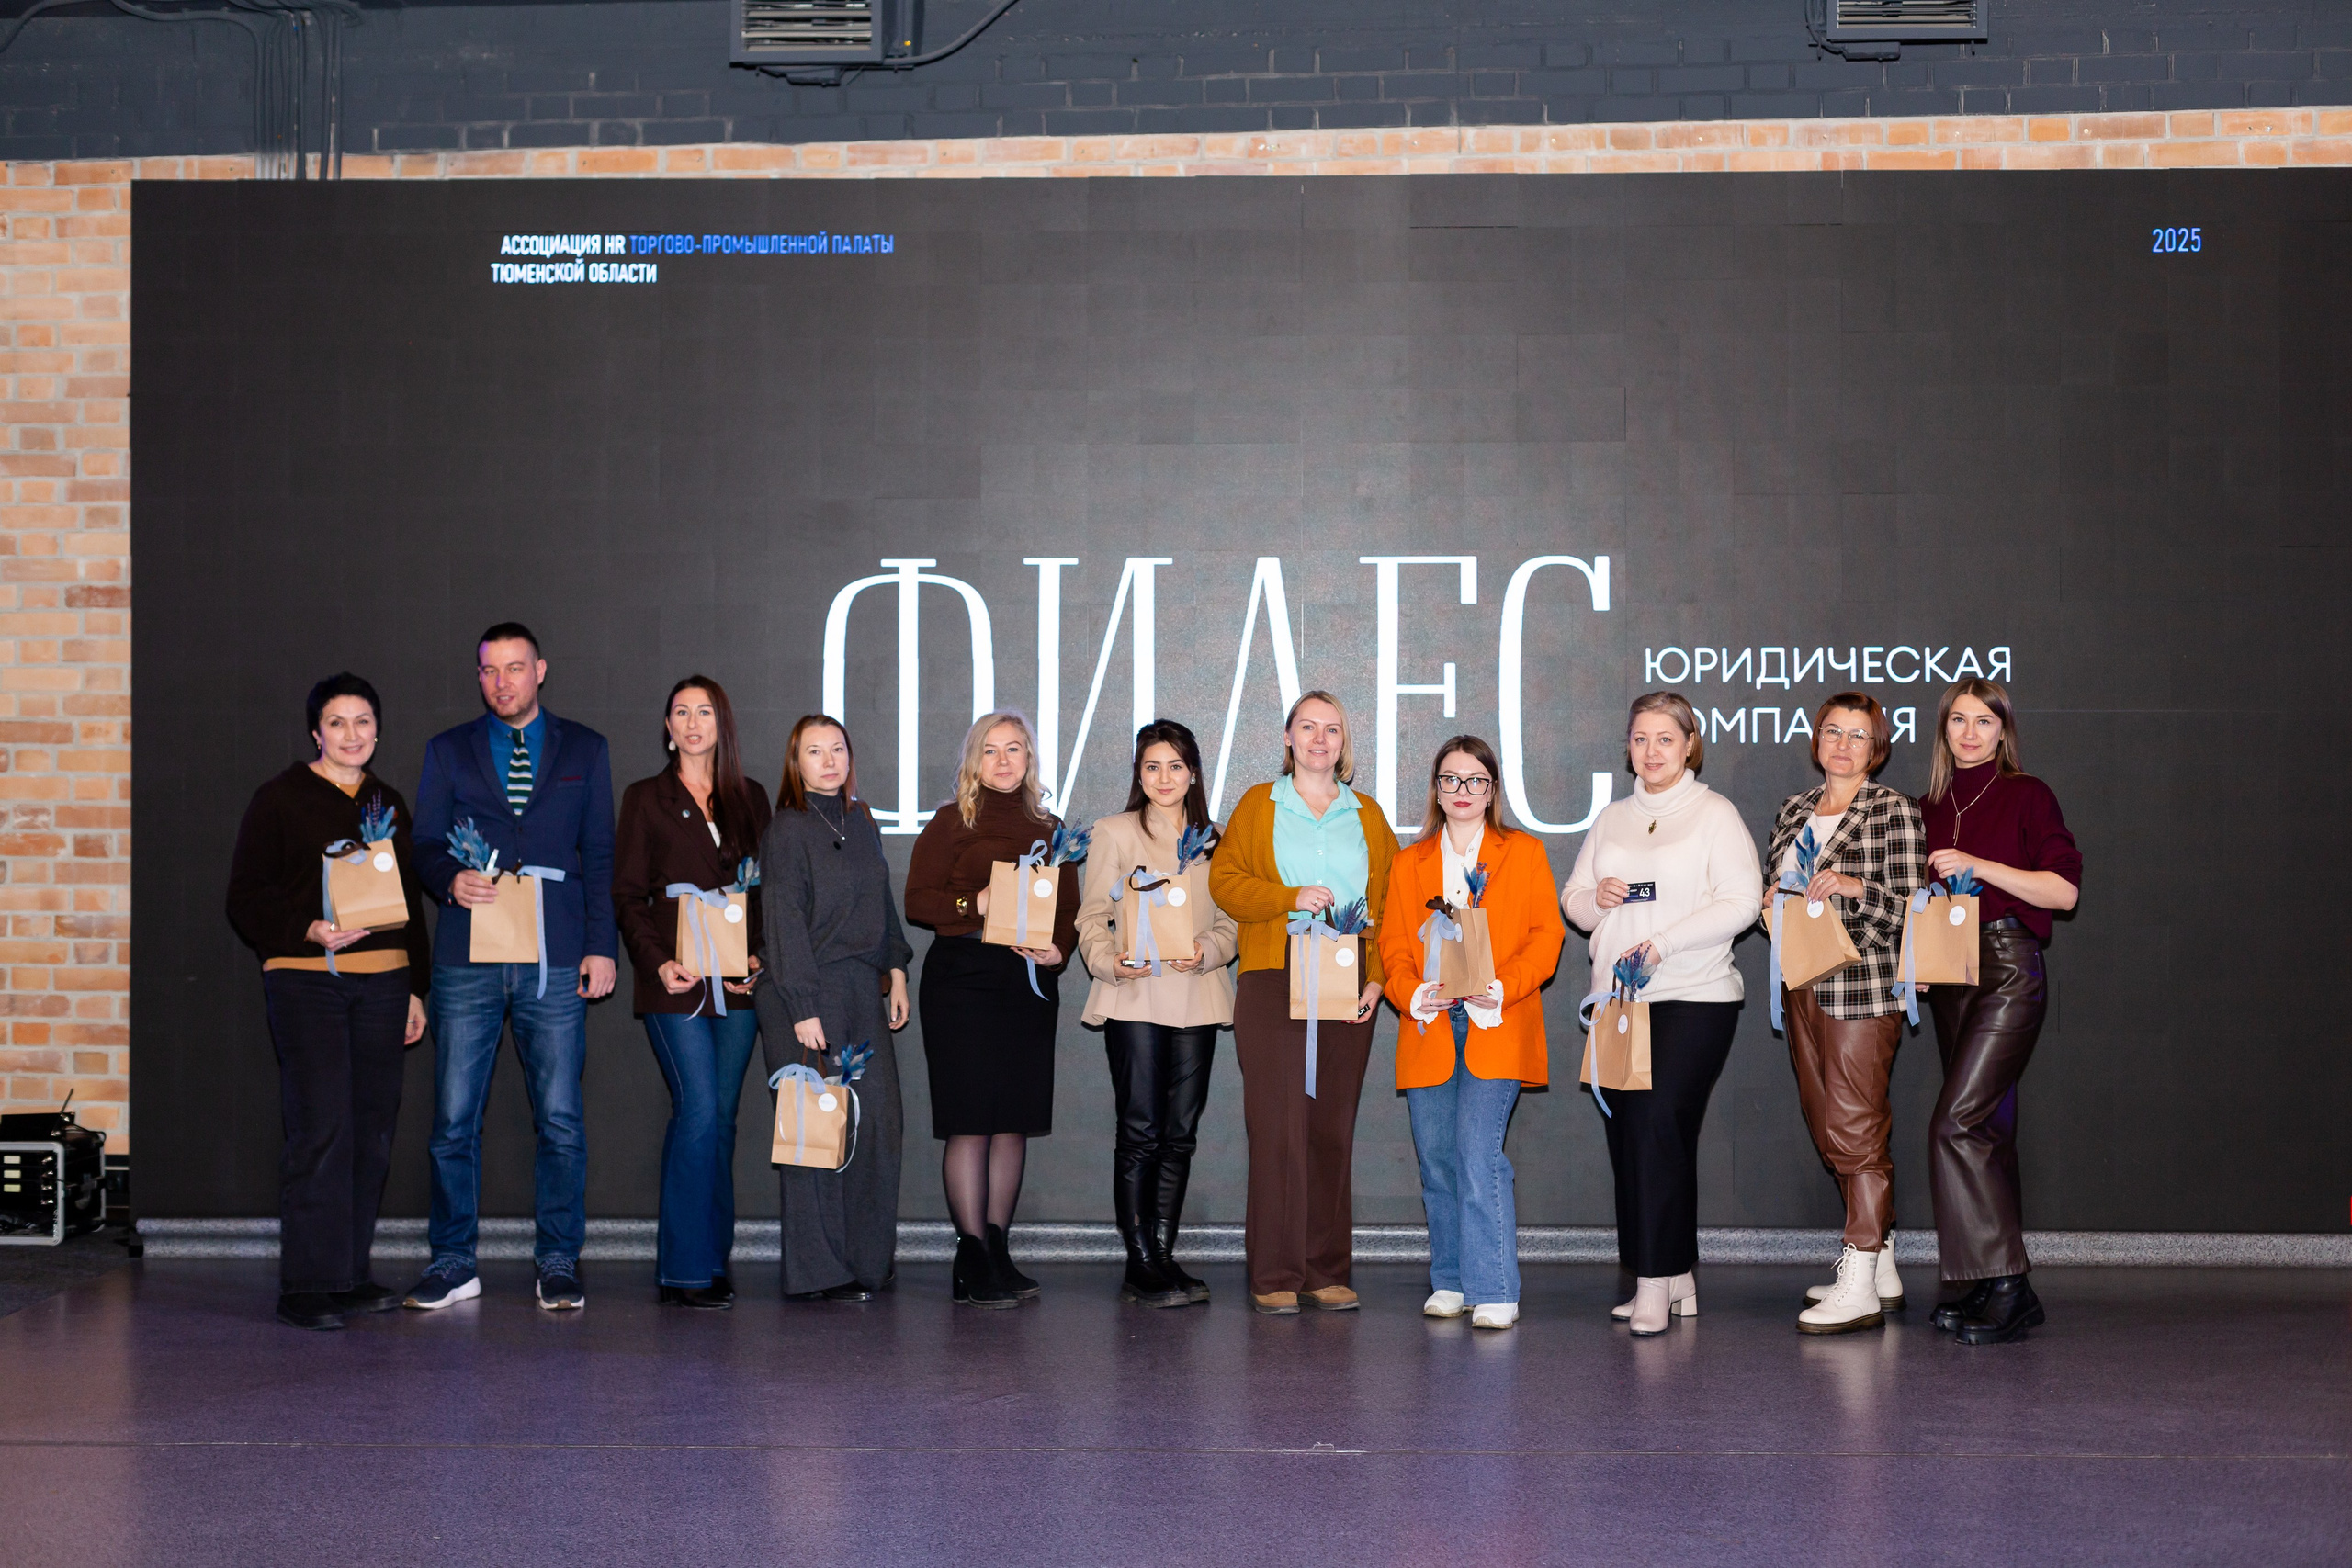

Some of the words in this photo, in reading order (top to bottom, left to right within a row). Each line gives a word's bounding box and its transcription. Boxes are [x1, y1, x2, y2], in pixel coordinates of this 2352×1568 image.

[501, 234, 602, 258] АССОЦИАЦИЯ
[605, 234, 626, 254] HR
[629, 231, 828, 254] ТОРГОВО-ПРОМЫШЛЕННОЙ
[831, 233, 894, 254] ПАЛАТЫ
[2152, 227, 2202, 253] 2025
[491, 257, 586, 284] ТЮМЕНСКОЙ
[588, 263, 658, 283] ОБЛАСТИ
[1645, 645, 2012, 690] ЮРИДИЧЕСКАЯ
[1639, 887, 1651, 897] 43
